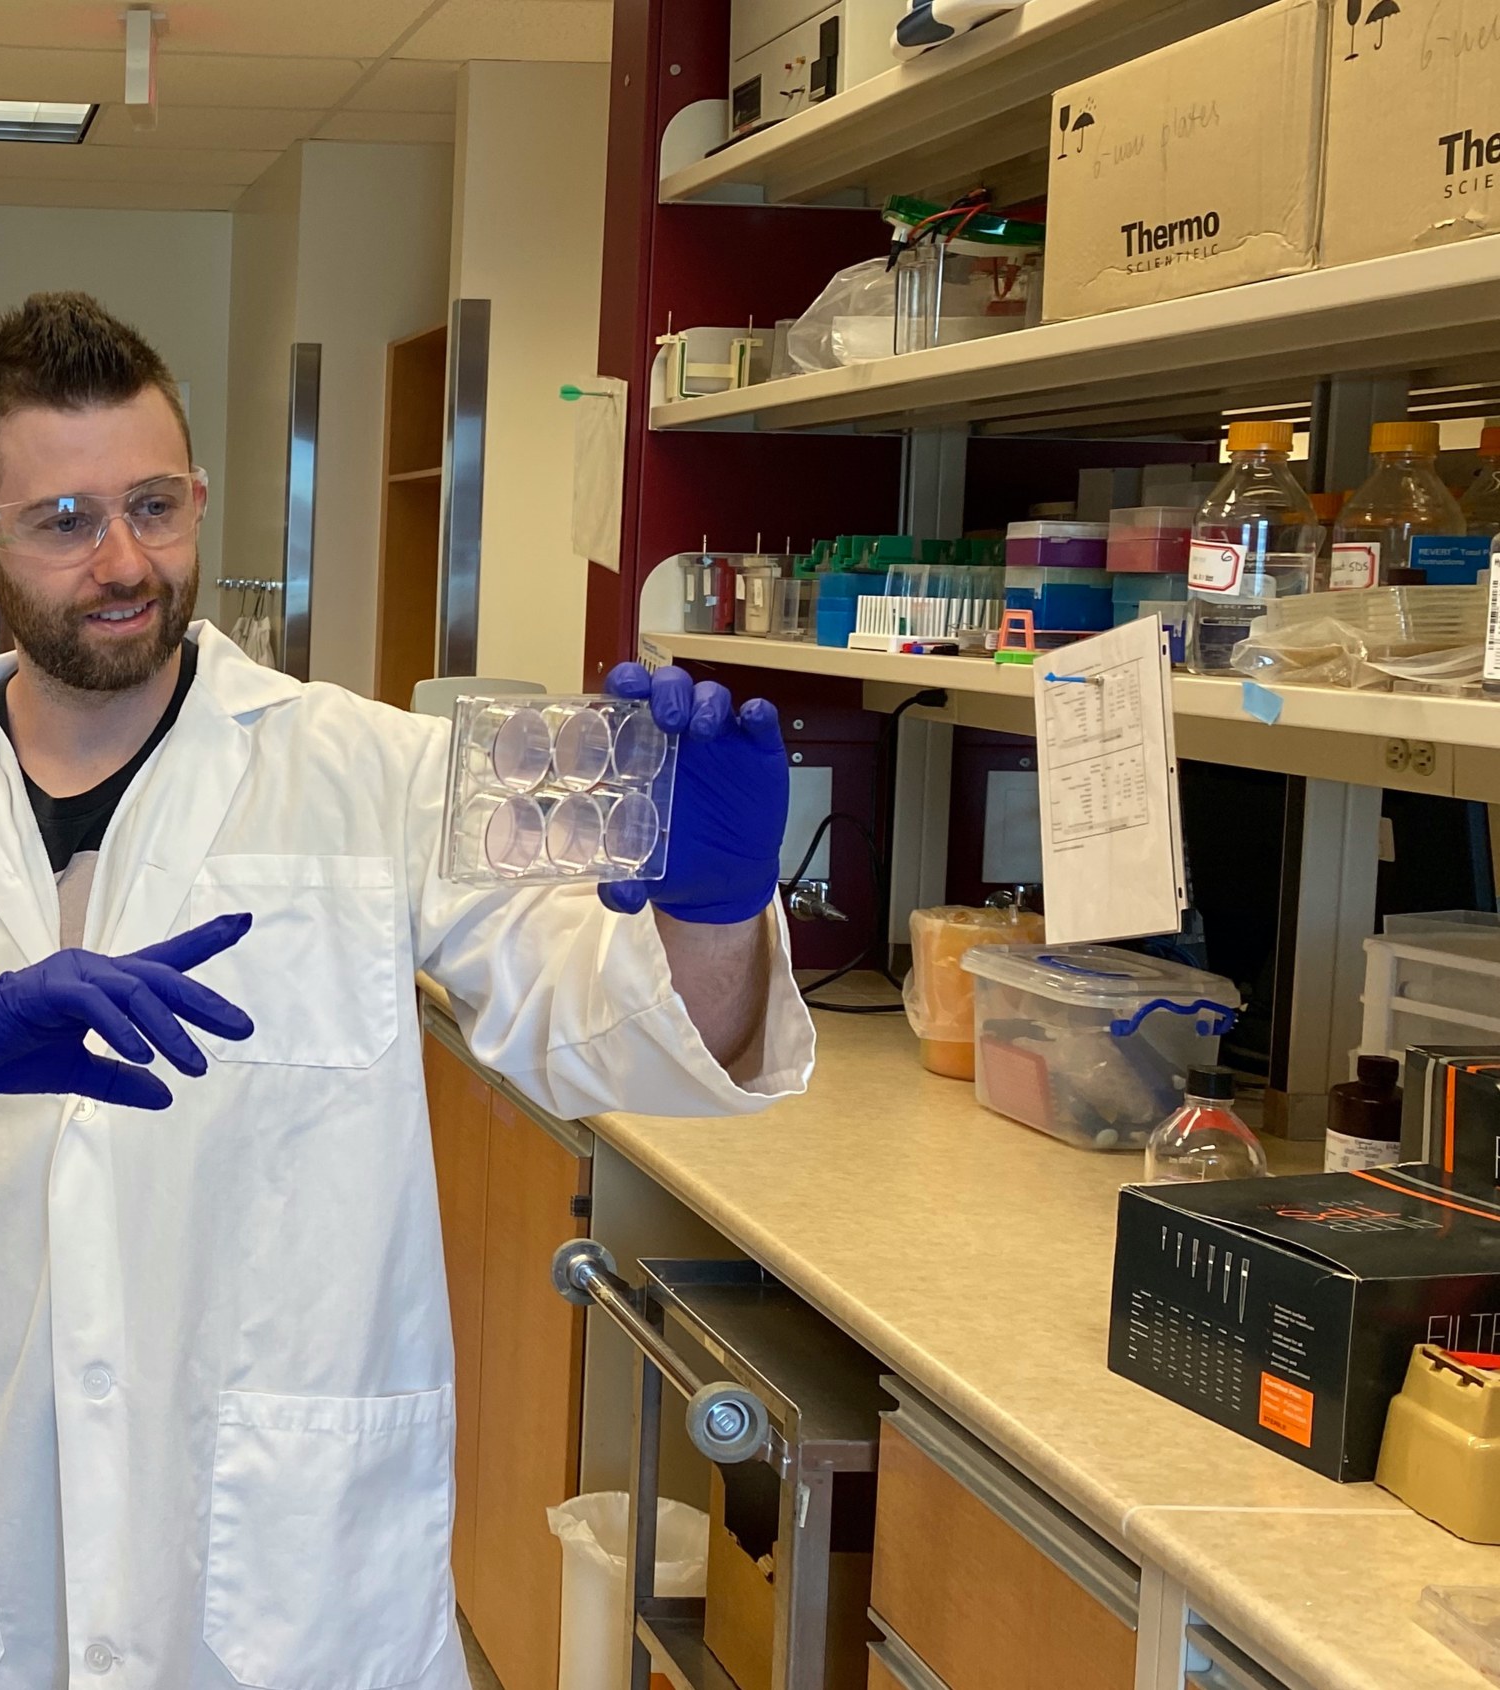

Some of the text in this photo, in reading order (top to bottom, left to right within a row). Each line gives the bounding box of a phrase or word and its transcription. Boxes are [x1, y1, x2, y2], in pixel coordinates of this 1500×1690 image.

[1161, 101, 1220, 160] plates
[1438, 128, 1500, 176] The
[1443, 173, 1495, 199] SCIE
[1121, 211, 1220, 257] Thermo
[1126, 243, 1219, 275] SCIENTIFIC
[1221, 549, 1233, 562] 6
[1348, 561, 1369, 572] SDS
[1276, 1205, 1402, 1221] TIPS
[1309, 1216, 1445, 1233] FILTER
